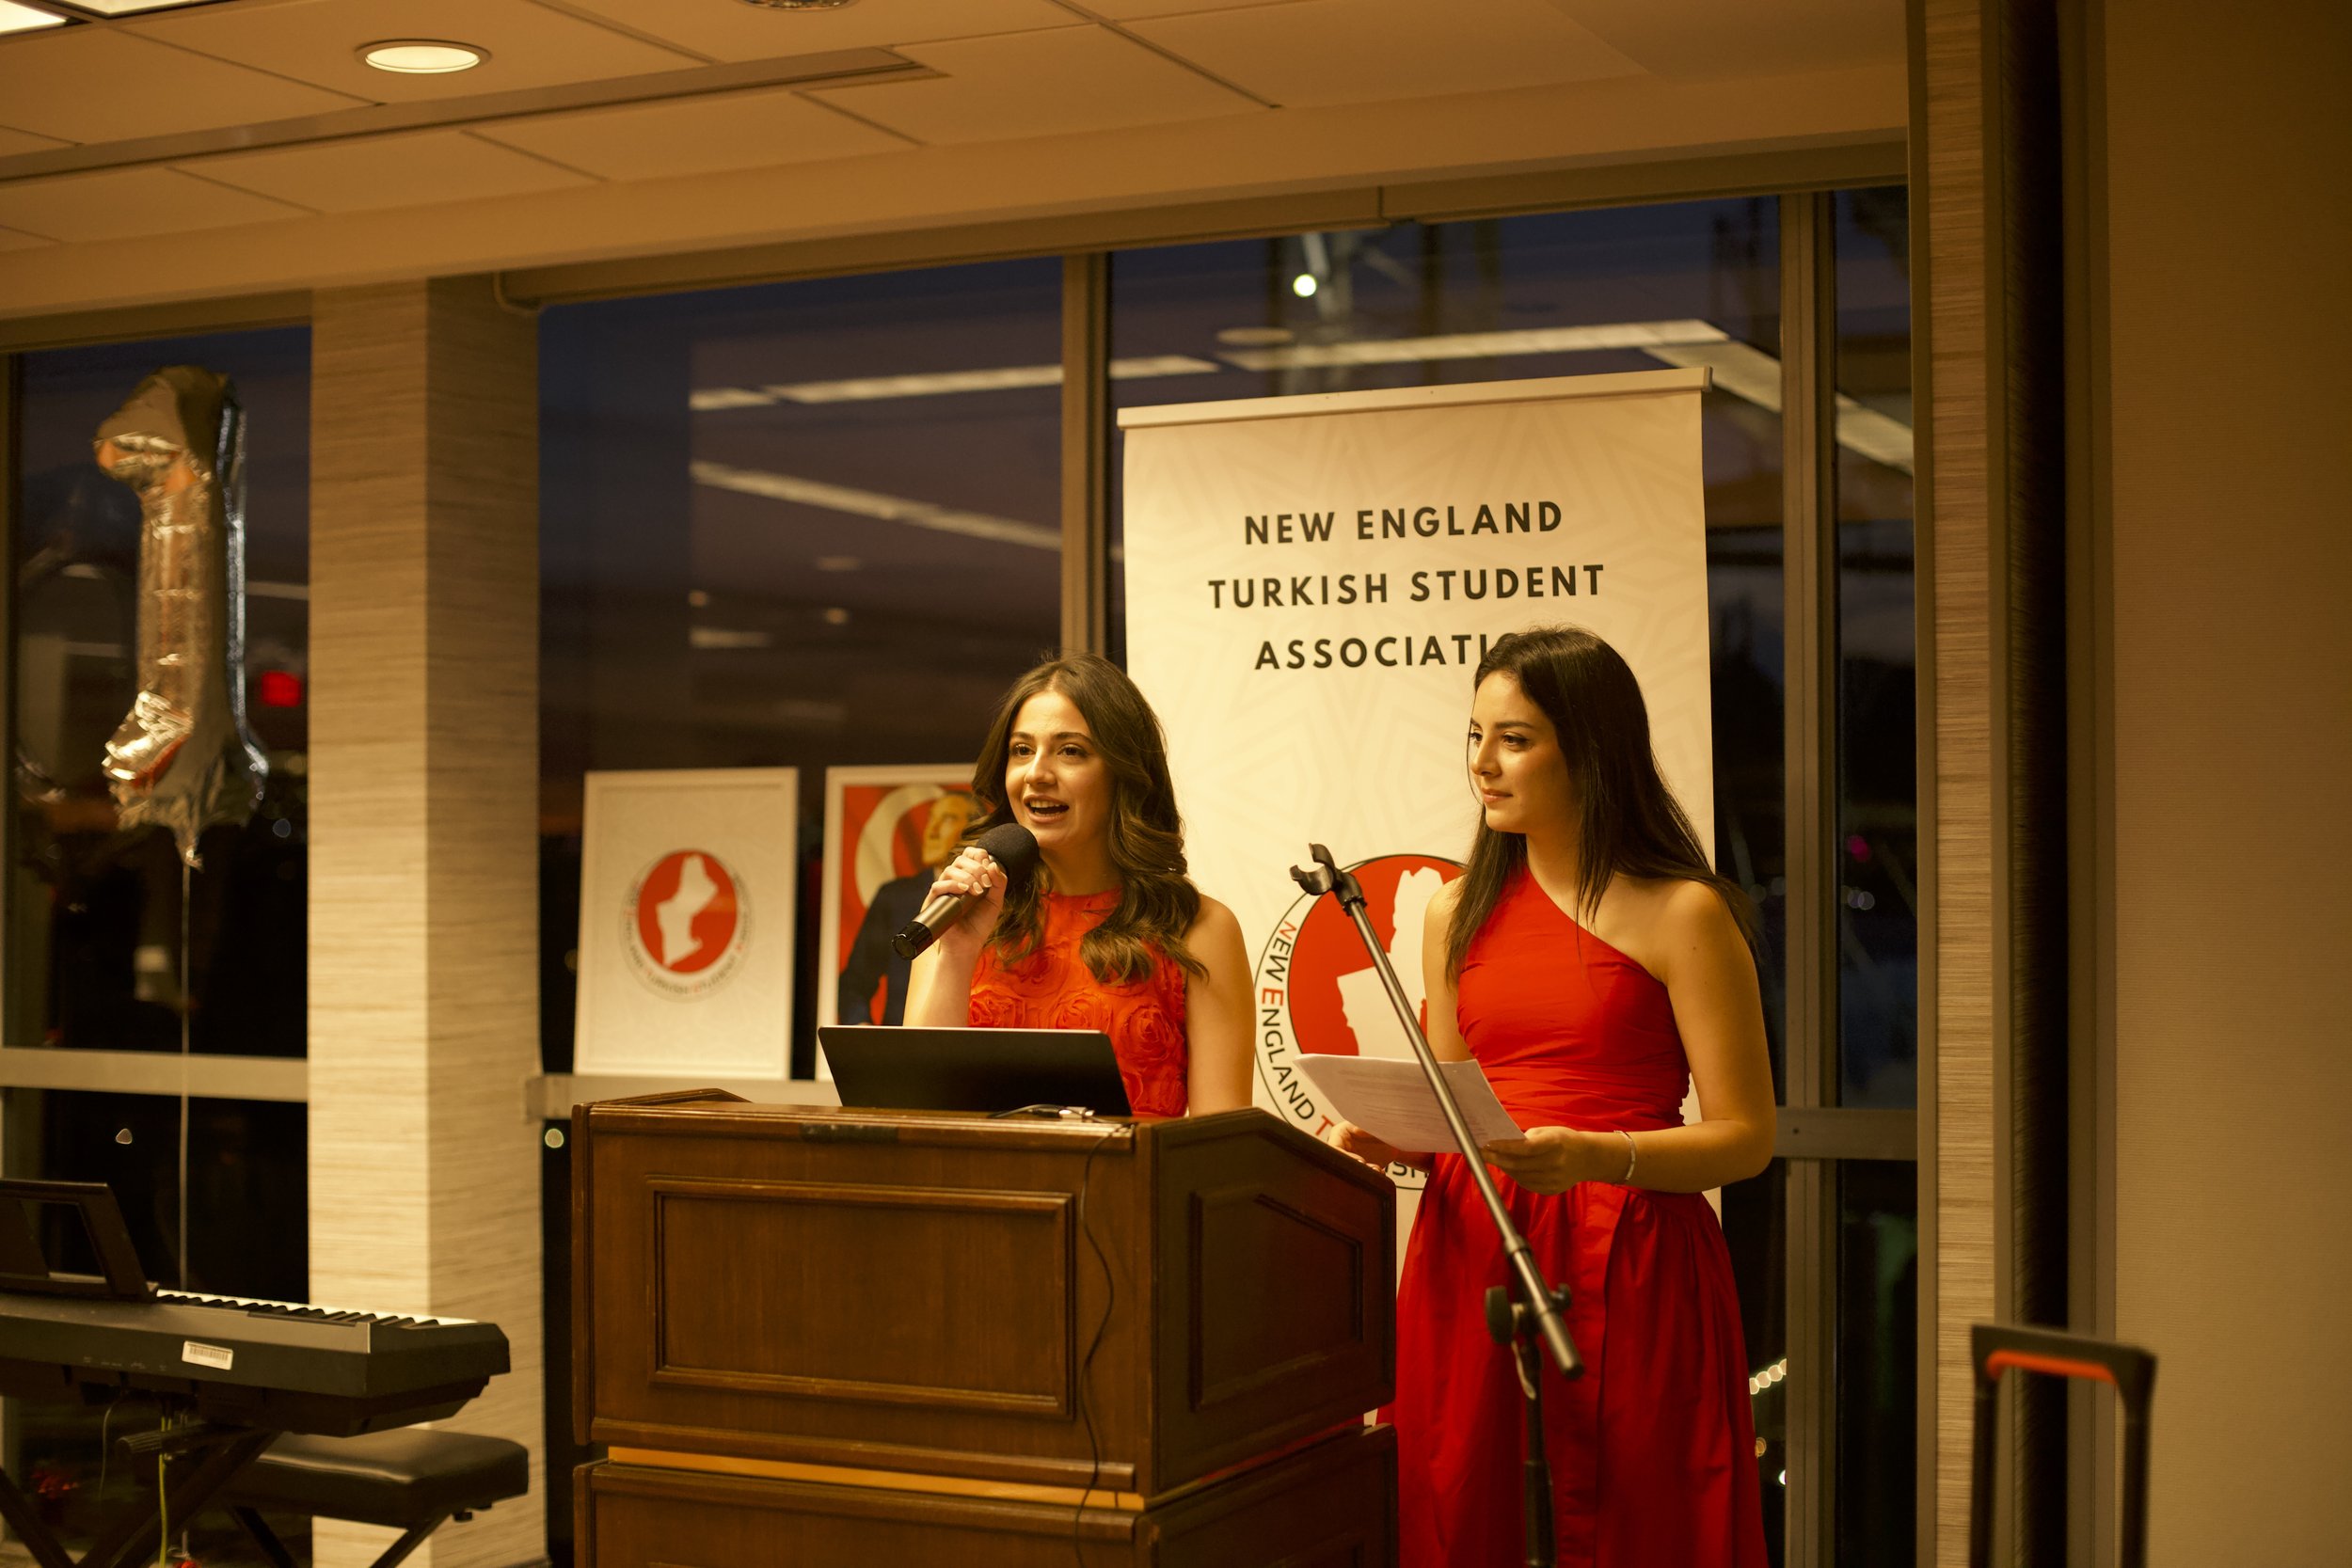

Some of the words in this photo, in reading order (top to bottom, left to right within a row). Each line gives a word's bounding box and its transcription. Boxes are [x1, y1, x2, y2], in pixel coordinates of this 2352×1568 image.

[1245, 511, 1335, 546] NEW
[1357, 500, 1563, 540] ENGLAND
[1208, 573, 1389, 609] TURKISH
[1409, 563, 1605, 602] STUDENT
[1254, 632, 1517, 671] ASSOCIATI
[1265, 920, 1297, 982] NEW
[1262, 988, 1315, 1120] ENGLAND
